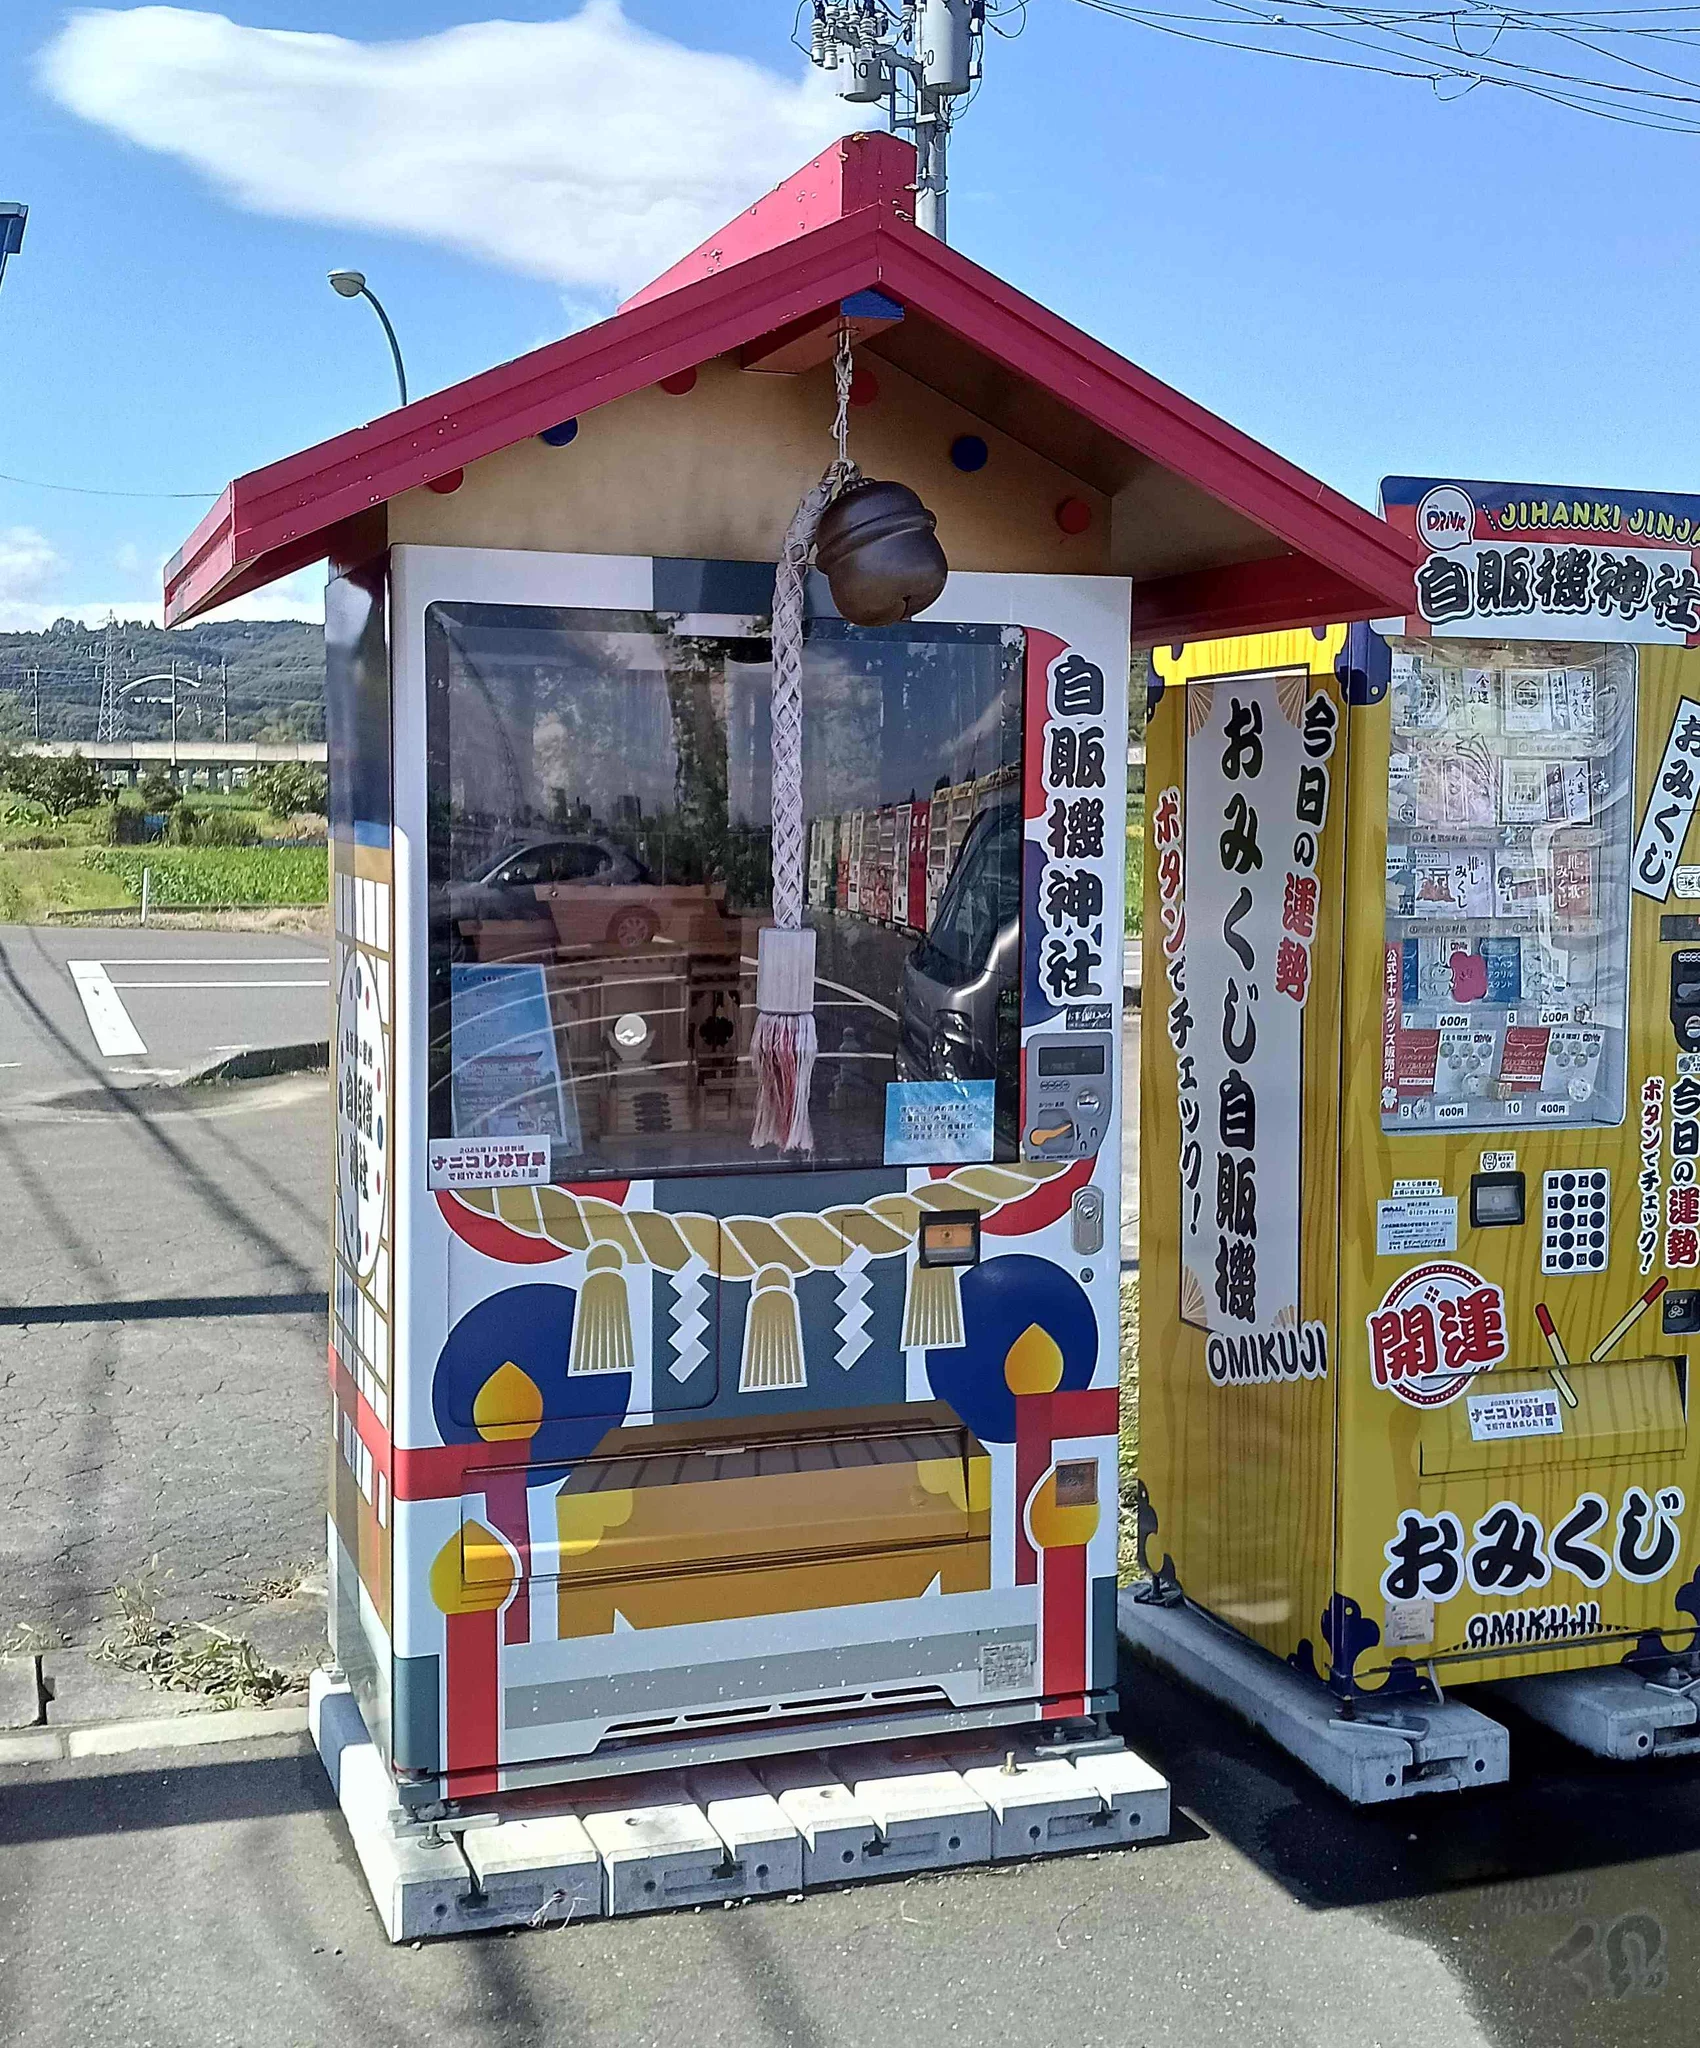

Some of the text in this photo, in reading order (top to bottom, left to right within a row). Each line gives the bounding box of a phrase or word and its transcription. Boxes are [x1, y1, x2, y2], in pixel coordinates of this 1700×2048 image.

[1426, 511, 1466, 532] DRINK
[1499, 501, 1621, 531] JIHANKI
[1418, 546, 1700, 631] 自販機神社
[1575, 768, 1587, 794] 人生
[1639, 715, 1700, 886] おみくじ
[1050, 656, 1105, 998] 自販機神社
[1277, 692, 1336, 1001] 今日の運勢
[1455, 865, 1468, 909] みくじ
[1214, 698, 1262, 1321] おみくじ自販機
[1384, 949, 1398, 1083] 公式キャラグッズ販売中
[1405, 1015, 1411, 1026] 7
[1439, 1016, 1468, 1027] 600円
[1508, 1013, 1515, 1023] 8
[1541, 1011, 1569, 1023] 600円
[1402, 1107, 1409, 1116] 9
[1439, 1107, 1464, 1117] 400円
[1508, 1104, 1520, 1113] 10
[1540, 1104, 1565, 1114] 400円
[1668, 1079, 1700, 1266] 今日の運勢
[1208, 1326, 1327, 1384] OMIKUJI
[1371, 1288, 1505, 1385] 開運
[1387, 1493, 1680, 1600] おみくじ
